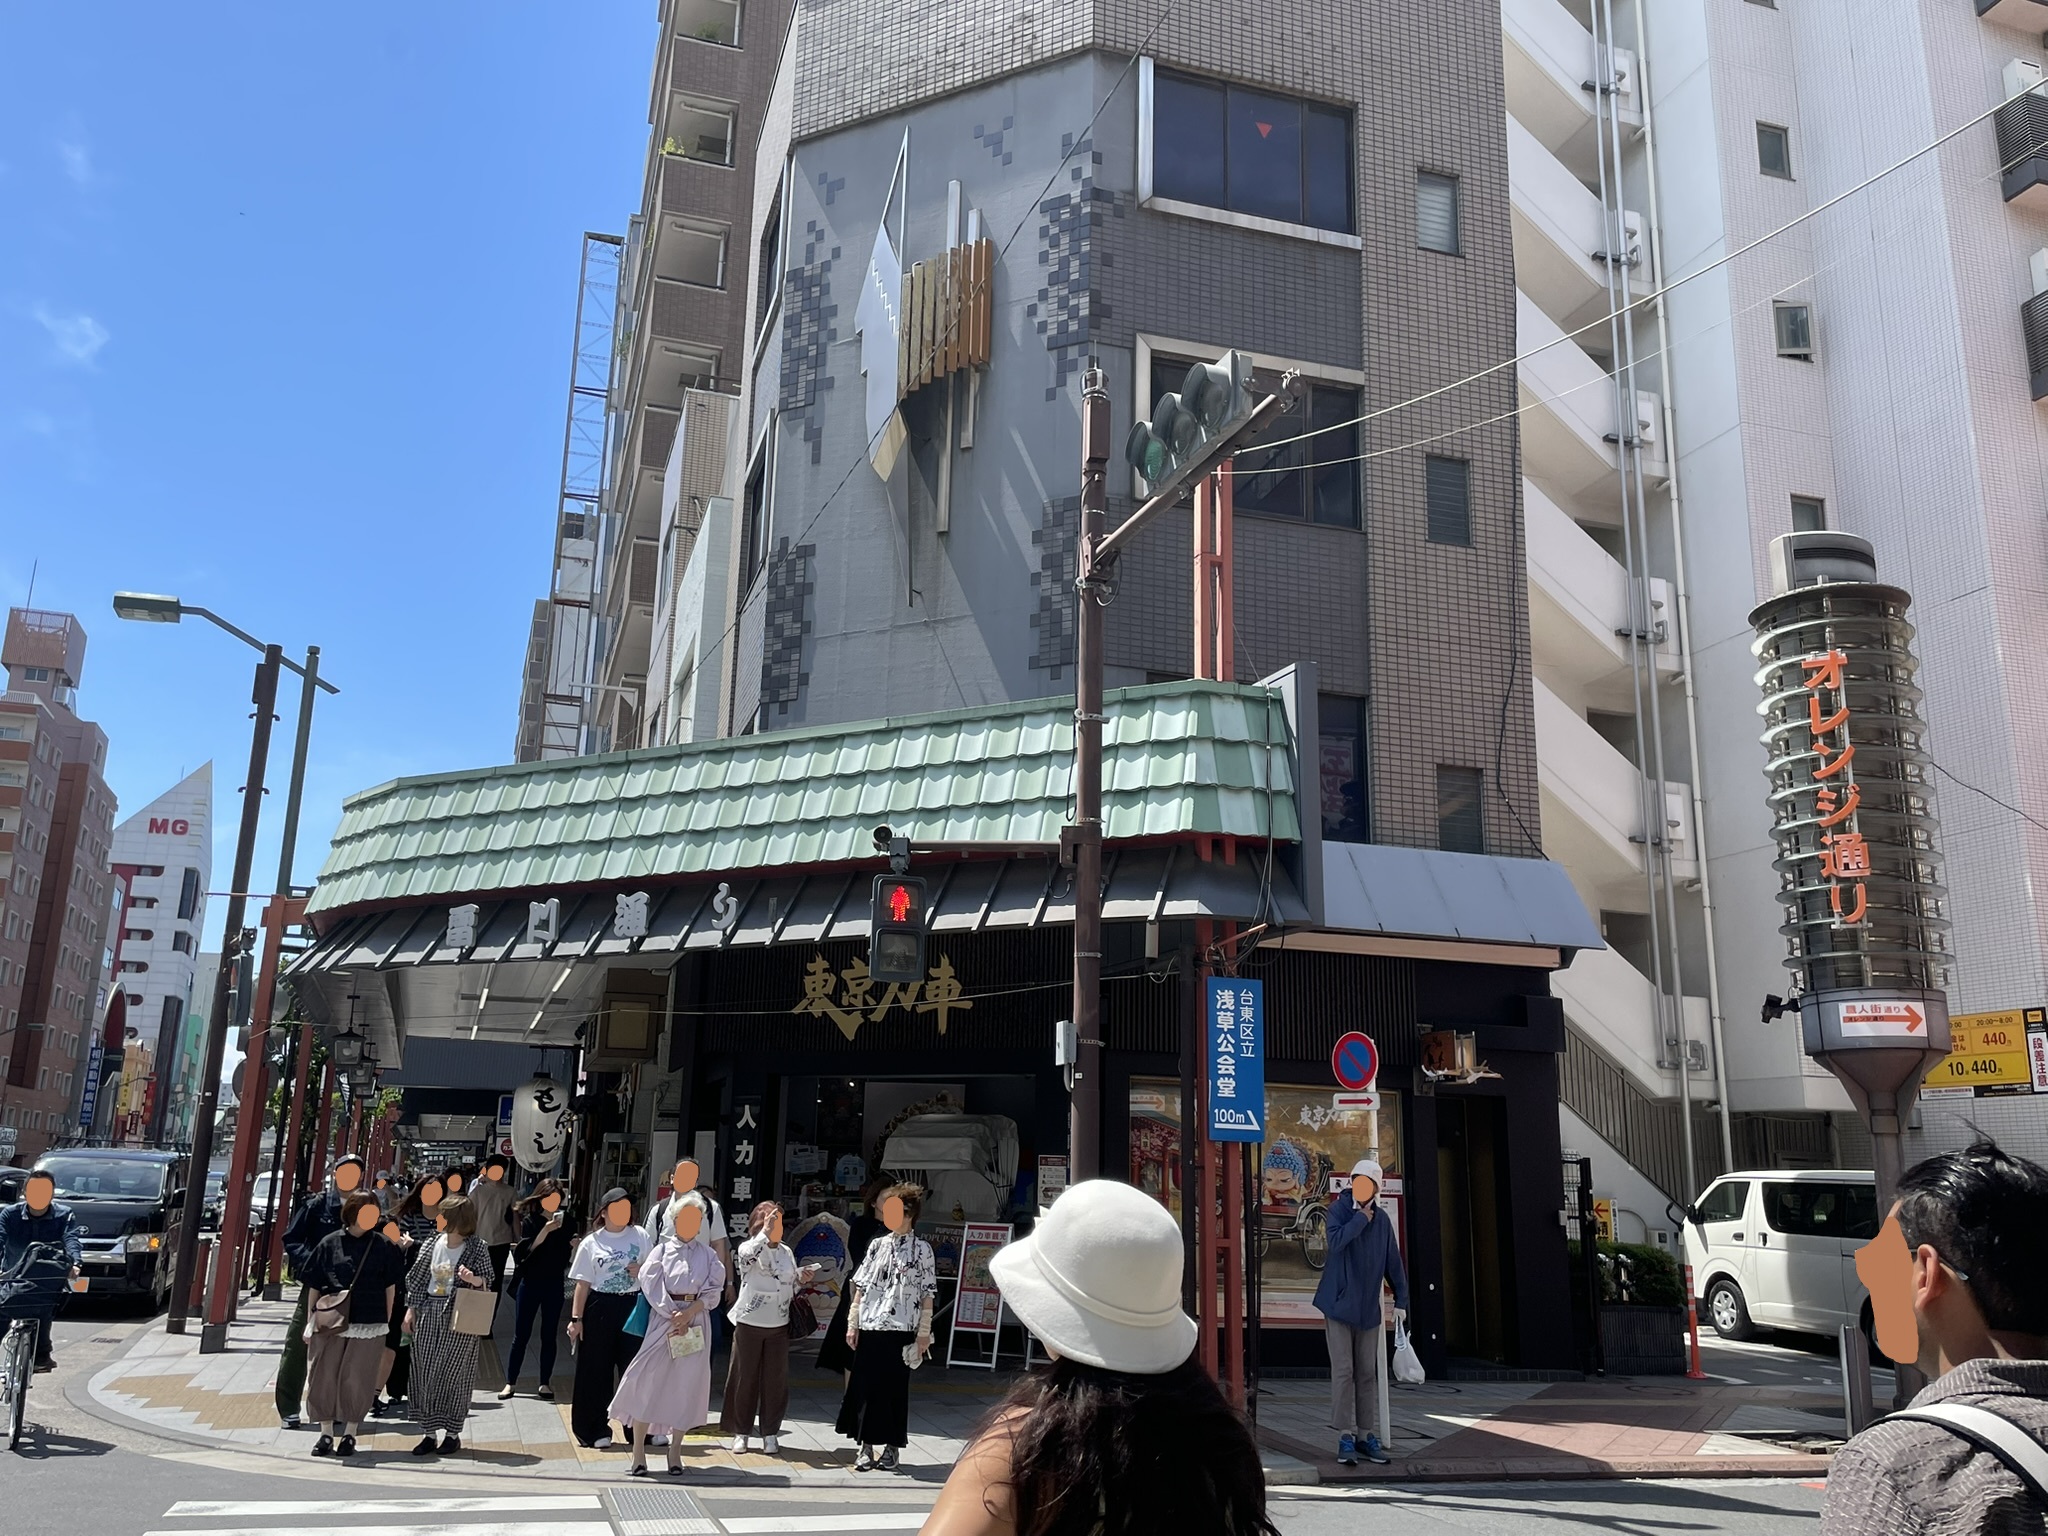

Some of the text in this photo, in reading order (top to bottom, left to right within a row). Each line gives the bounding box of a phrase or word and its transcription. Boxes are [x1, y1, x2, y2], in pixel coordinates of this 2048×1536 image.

[1801, 650, 1872, 923] オレンジ通り
[149, 817, 189, 835] MG
[446, 882, 738, 947] 雷門通り
[1216, 989, 1236, 1098] 浅草公会堂
[1239, 988, 1255, 1058] 台東区立
[1214, 1108, 1245, 1124] 100m
[968, 1231, 1007, 1240] 人力車観光
